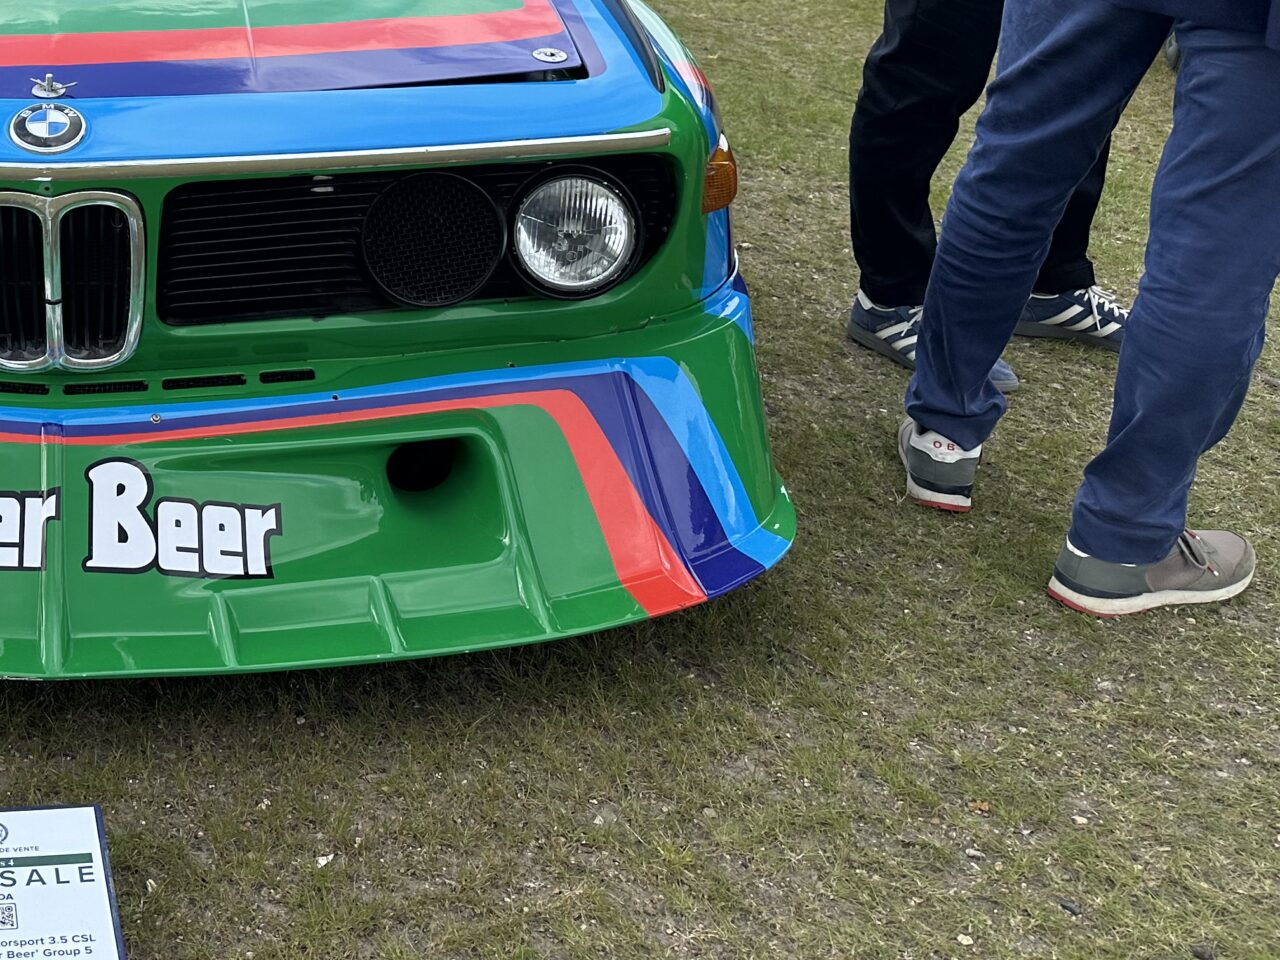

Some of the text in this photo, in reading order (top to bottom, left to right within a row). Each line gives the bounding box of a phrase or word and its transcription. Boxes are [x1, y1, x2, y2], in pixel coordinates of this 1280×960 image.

[83, 456, 282, 578] Beer
[0, 865, 95, 887] SALE
[48, 936, 67, 944] 3.5
[72, 934, 96, 943] CSL
[43, 947, 81, 957] Group
[84, 946, 93, 954] 5
